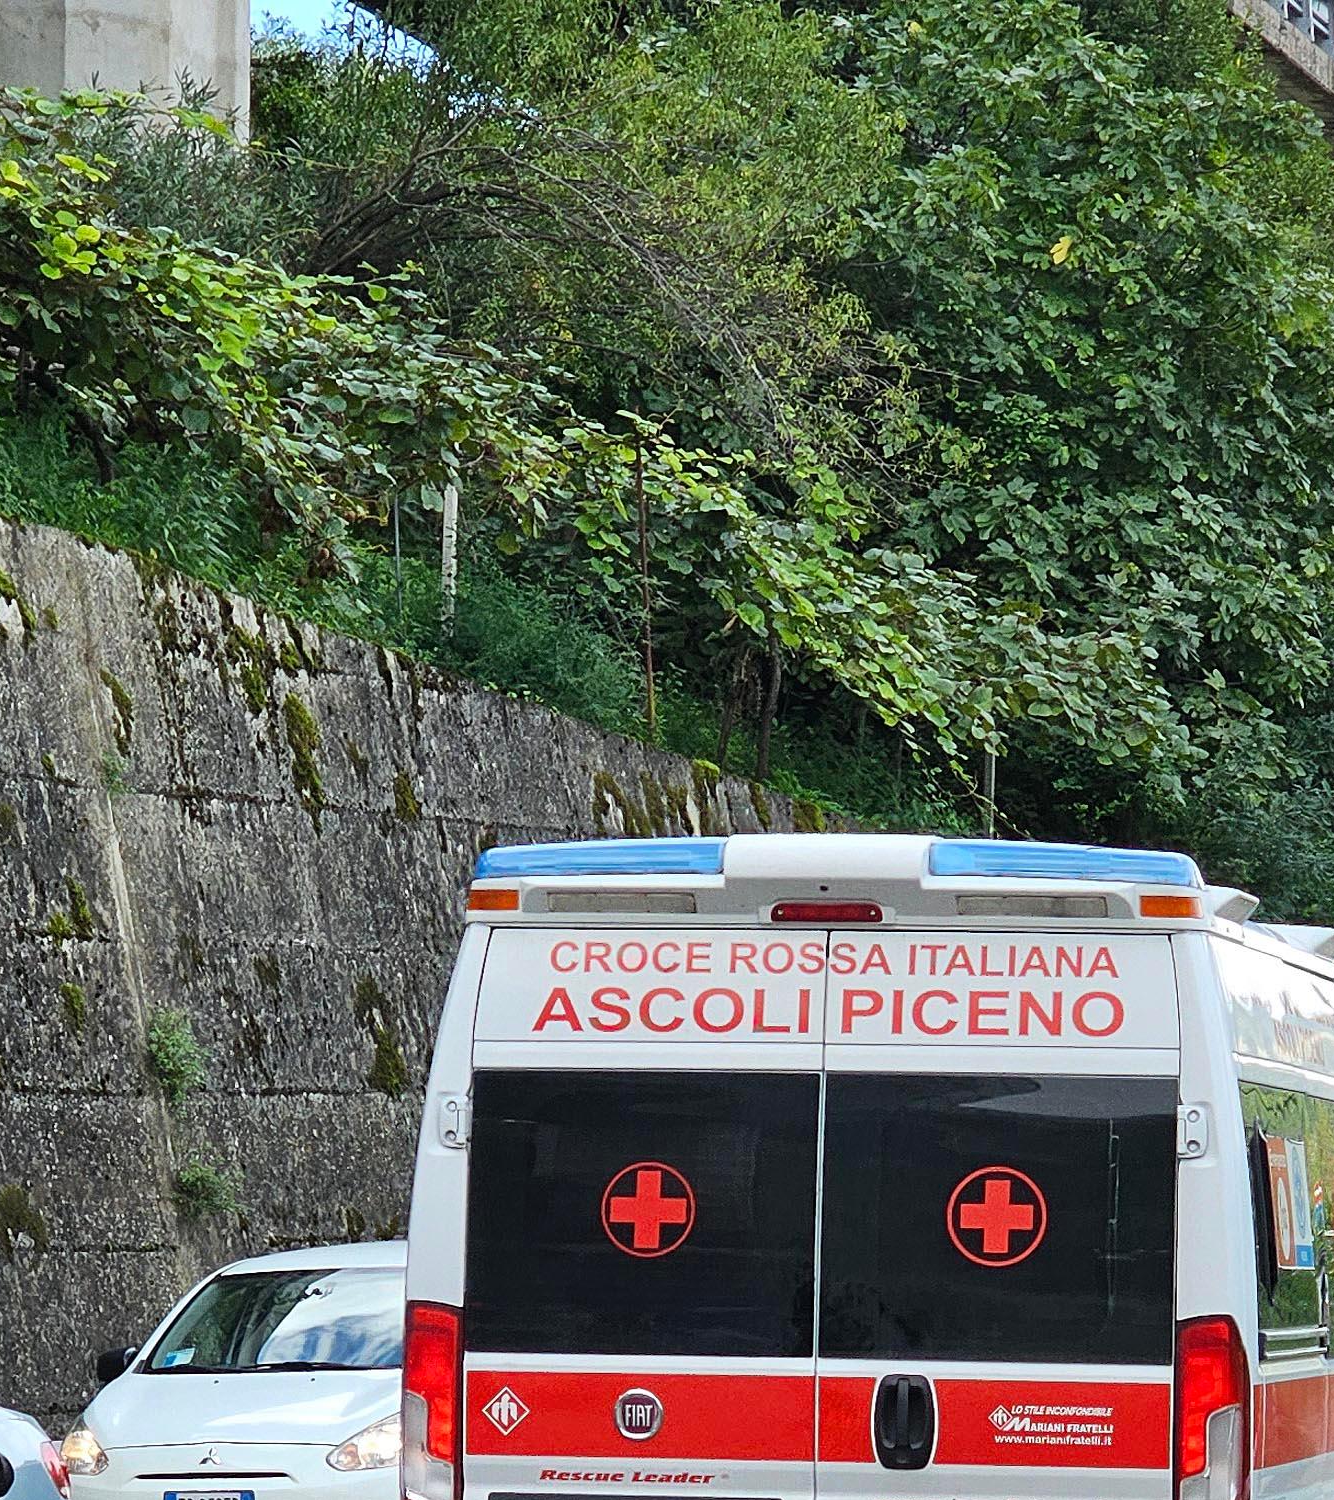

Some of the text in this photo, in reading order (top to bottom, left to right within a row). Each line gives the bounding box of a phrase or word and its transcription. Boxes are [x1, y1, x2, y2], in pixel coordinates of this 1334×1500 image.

[550, 940, 1120, 979] CROCE ROSSA ITALIANA
[532, 986, 1124, 1038] ASCOLI PICENO
[625, 1404, 654, 1427] FIAT
[1066, 1423, 1114, 1434] FRATELLI
[994, 1434, 1112, 1446] www.marianifratelli.it
[539, 1469, 715, 1485] Rescue Leader
